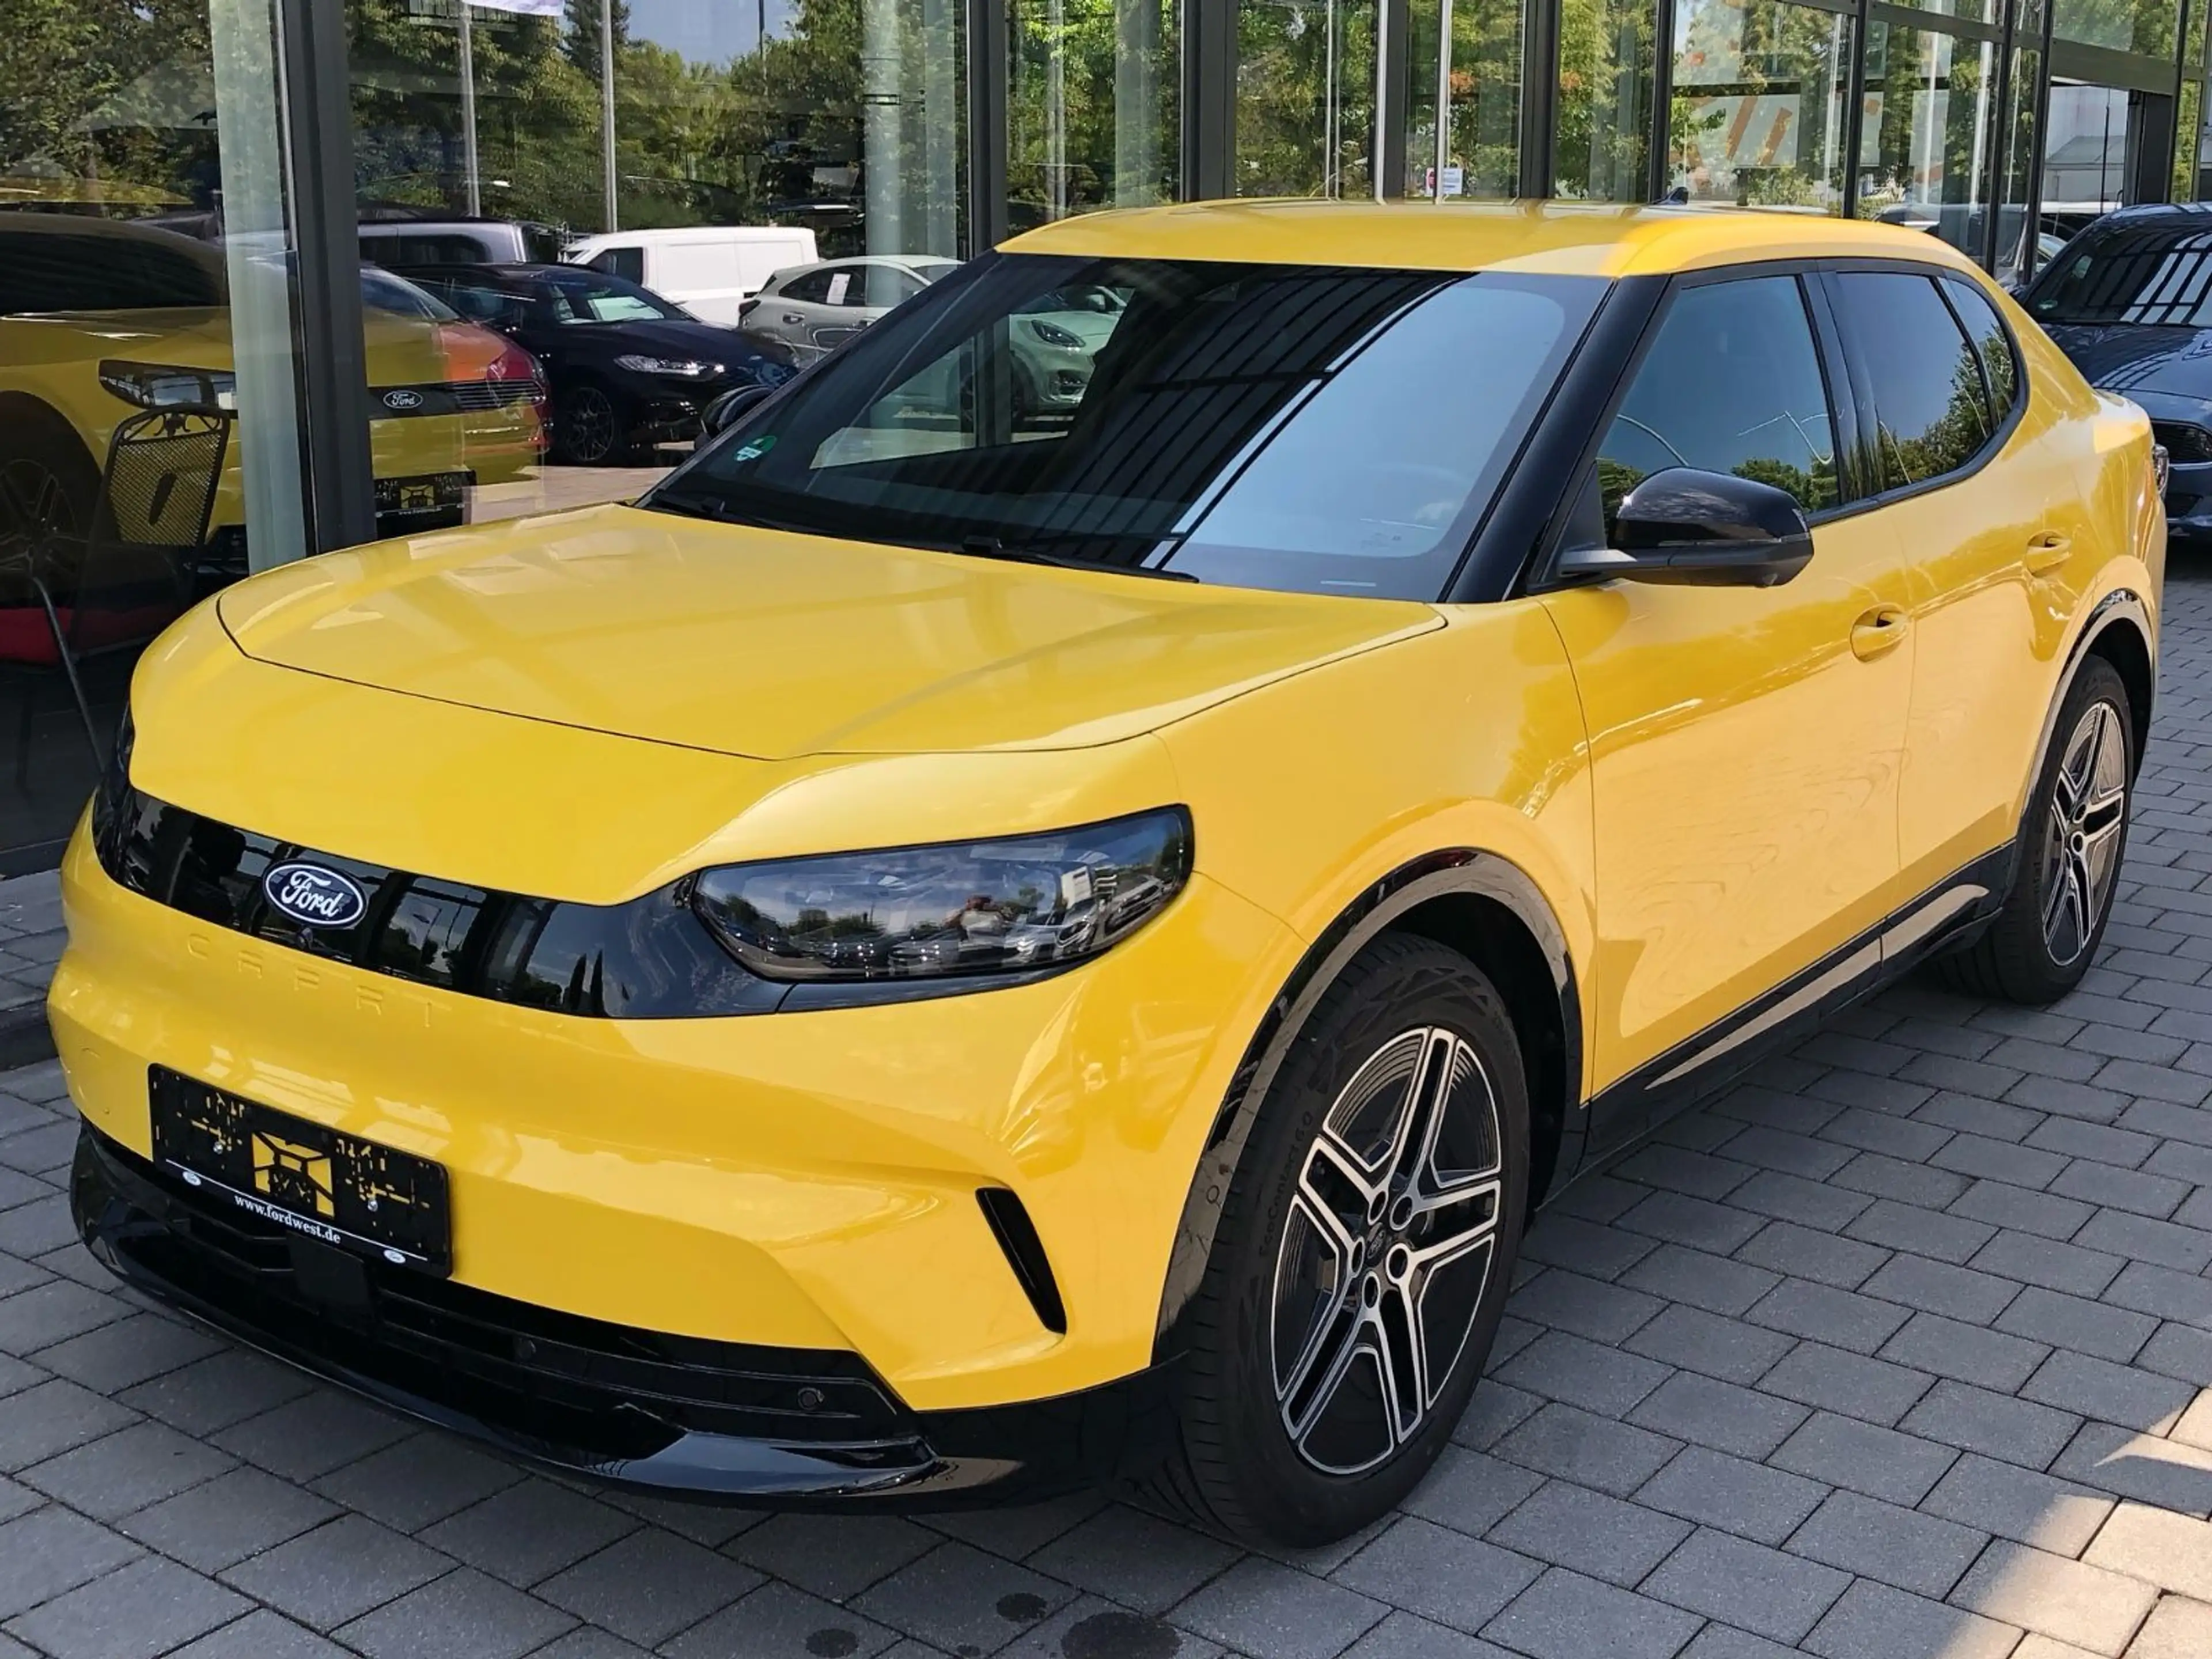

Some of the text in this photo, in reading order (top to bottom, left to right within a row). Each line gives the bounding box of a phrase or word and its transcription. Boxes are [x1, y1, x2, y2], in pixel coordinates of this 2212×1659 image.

[391, 393, 415, 406] Ford
[281, 870, 344, 918] Ford
[187, 933, 431, 1028] CAPRI
[233, 1193, 341, 1244] www.fordwest.de
